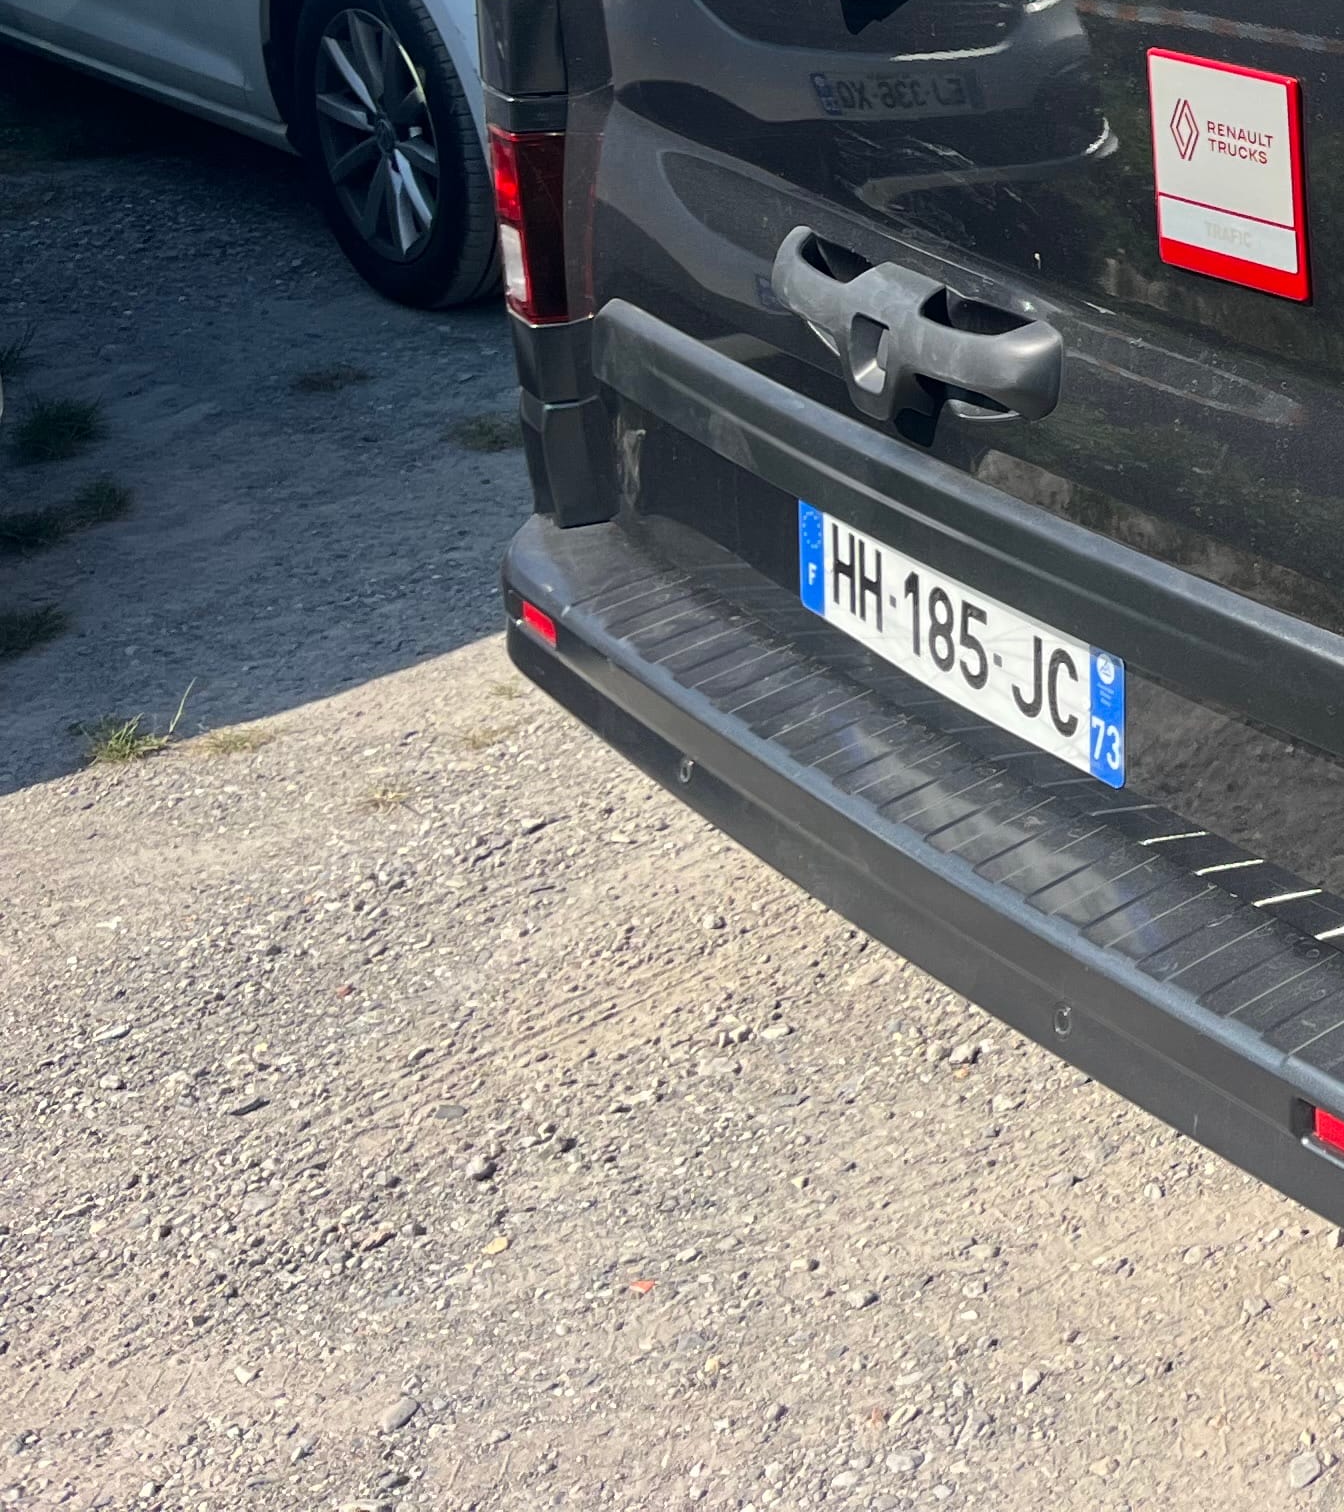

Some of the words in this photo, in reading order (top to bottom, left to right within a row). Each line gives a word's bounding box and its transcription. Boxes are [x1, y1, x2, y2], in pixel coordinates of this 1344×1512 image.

[1206, 120, 1274, 148] RENAULT
[1208, 138, 1268, 165] TRUCKS
[1204, 220, 1251, 248] TRAFIC
[807, 562, 818, 586] F
[1091, 715, 1120, 771] 73
